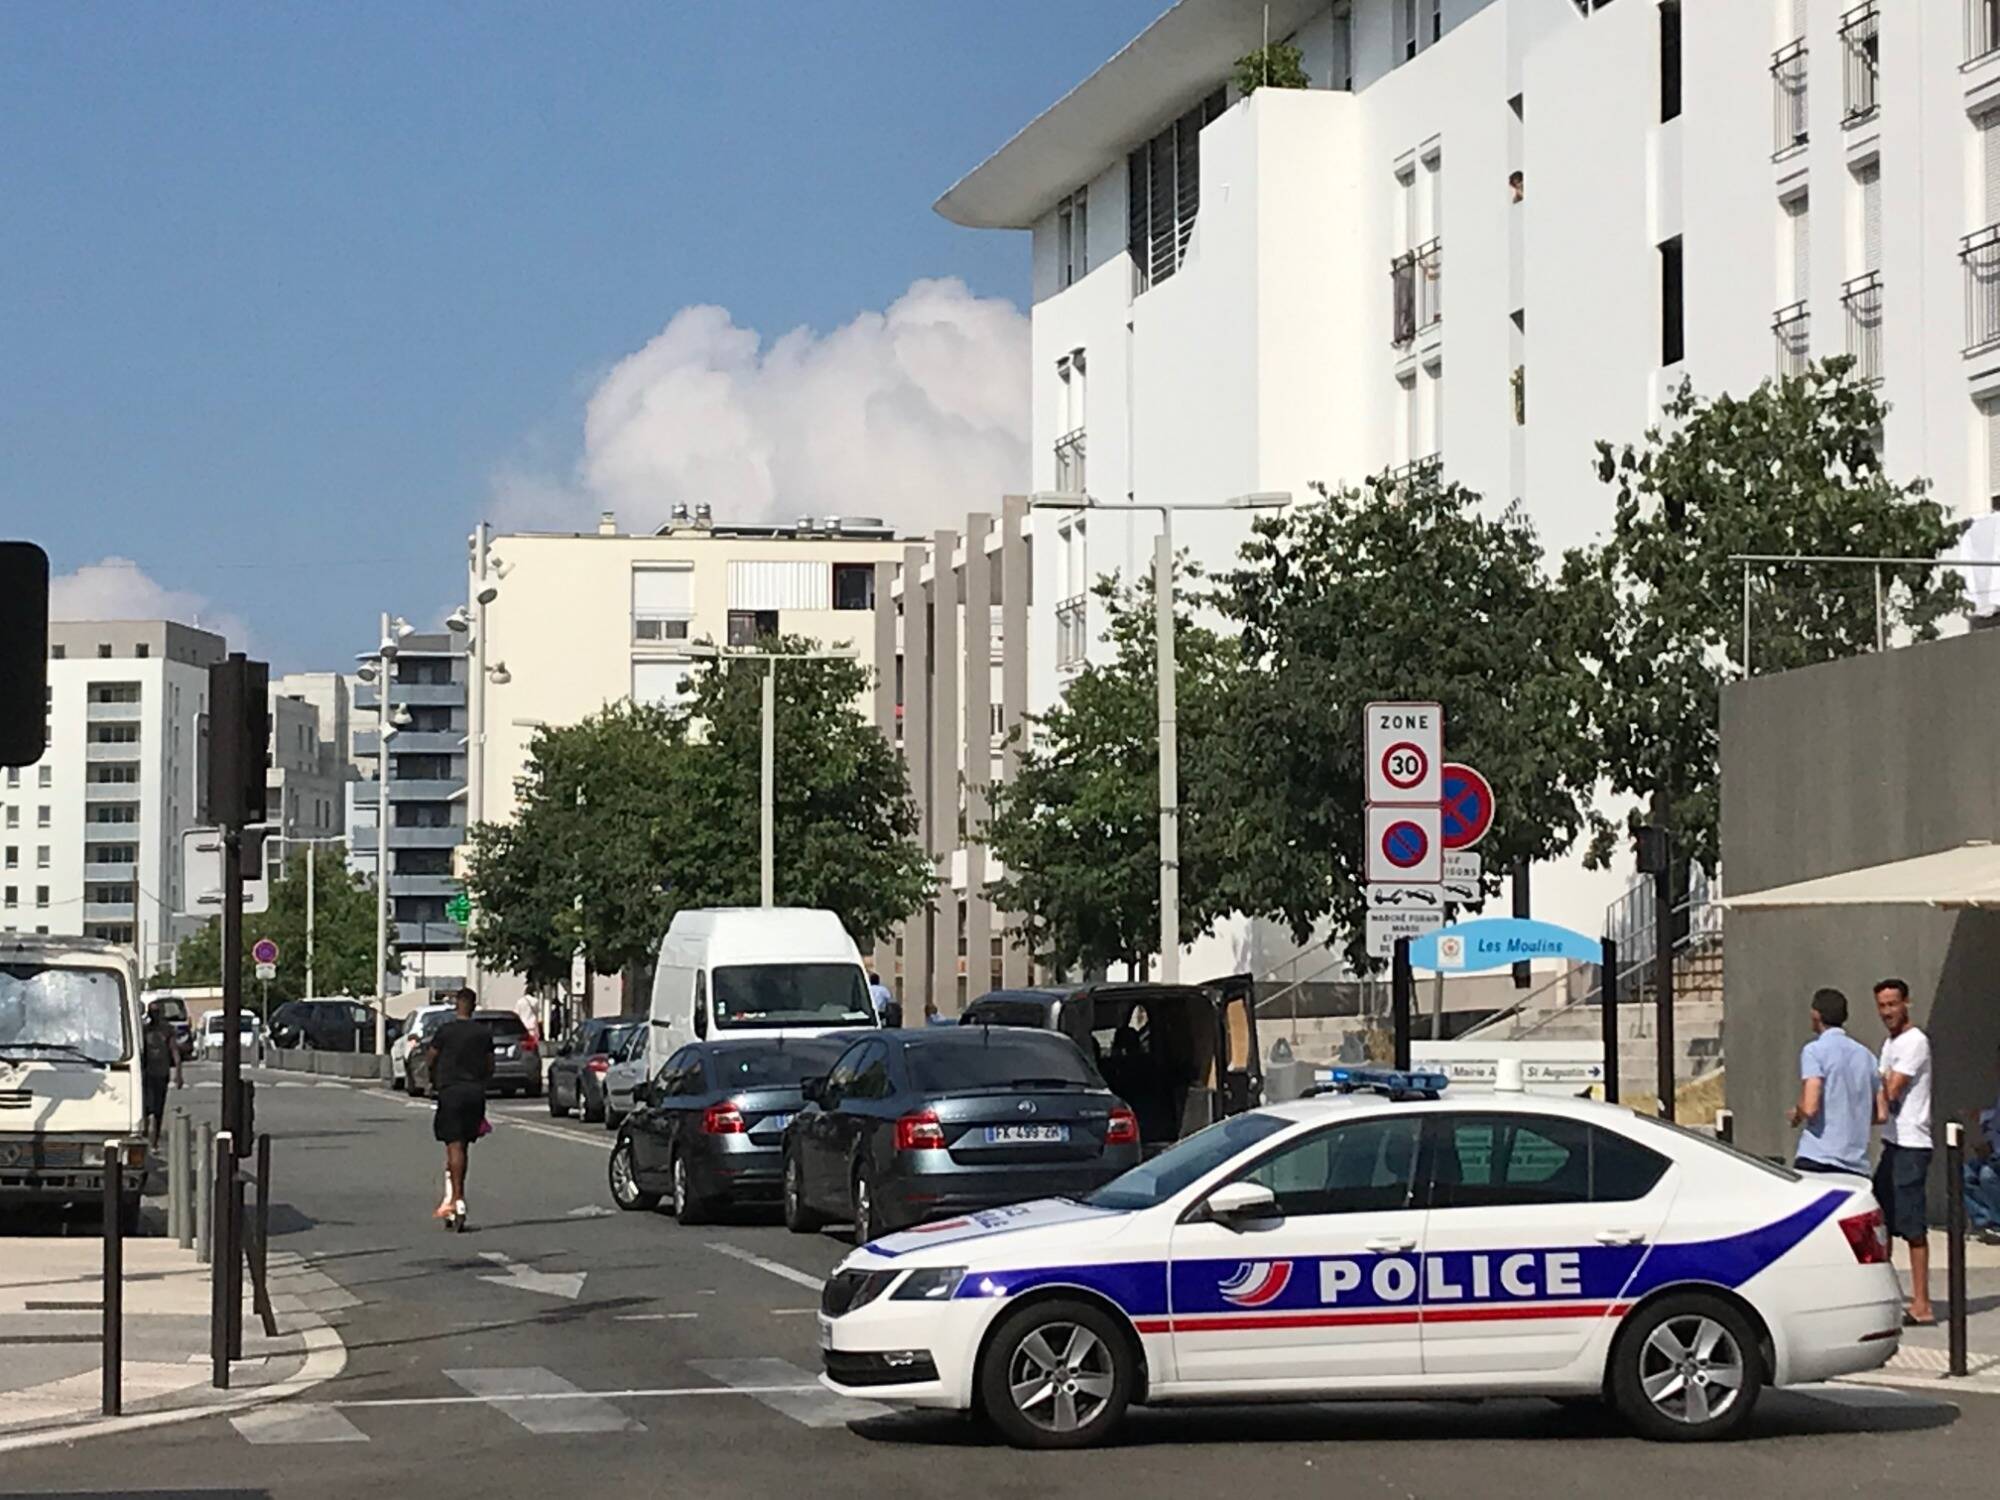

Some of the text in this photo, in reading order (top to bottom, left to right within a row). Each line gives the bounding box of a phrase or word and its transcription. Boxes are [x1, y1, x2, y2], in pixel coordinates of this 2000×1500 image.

[1380, 715, 1429, 729] ZONE
[1391, 755, 1419, 775] 30
[1478, 938, 1564, 954] Les Moulins
[1453, 1066, 1485, 1077] Mairie
[1527, 1066, 1538, 1077] St
[1542, 1066, 1586, 1081] Augustin
[1319, 1252, 1582, 1303] POLICE
